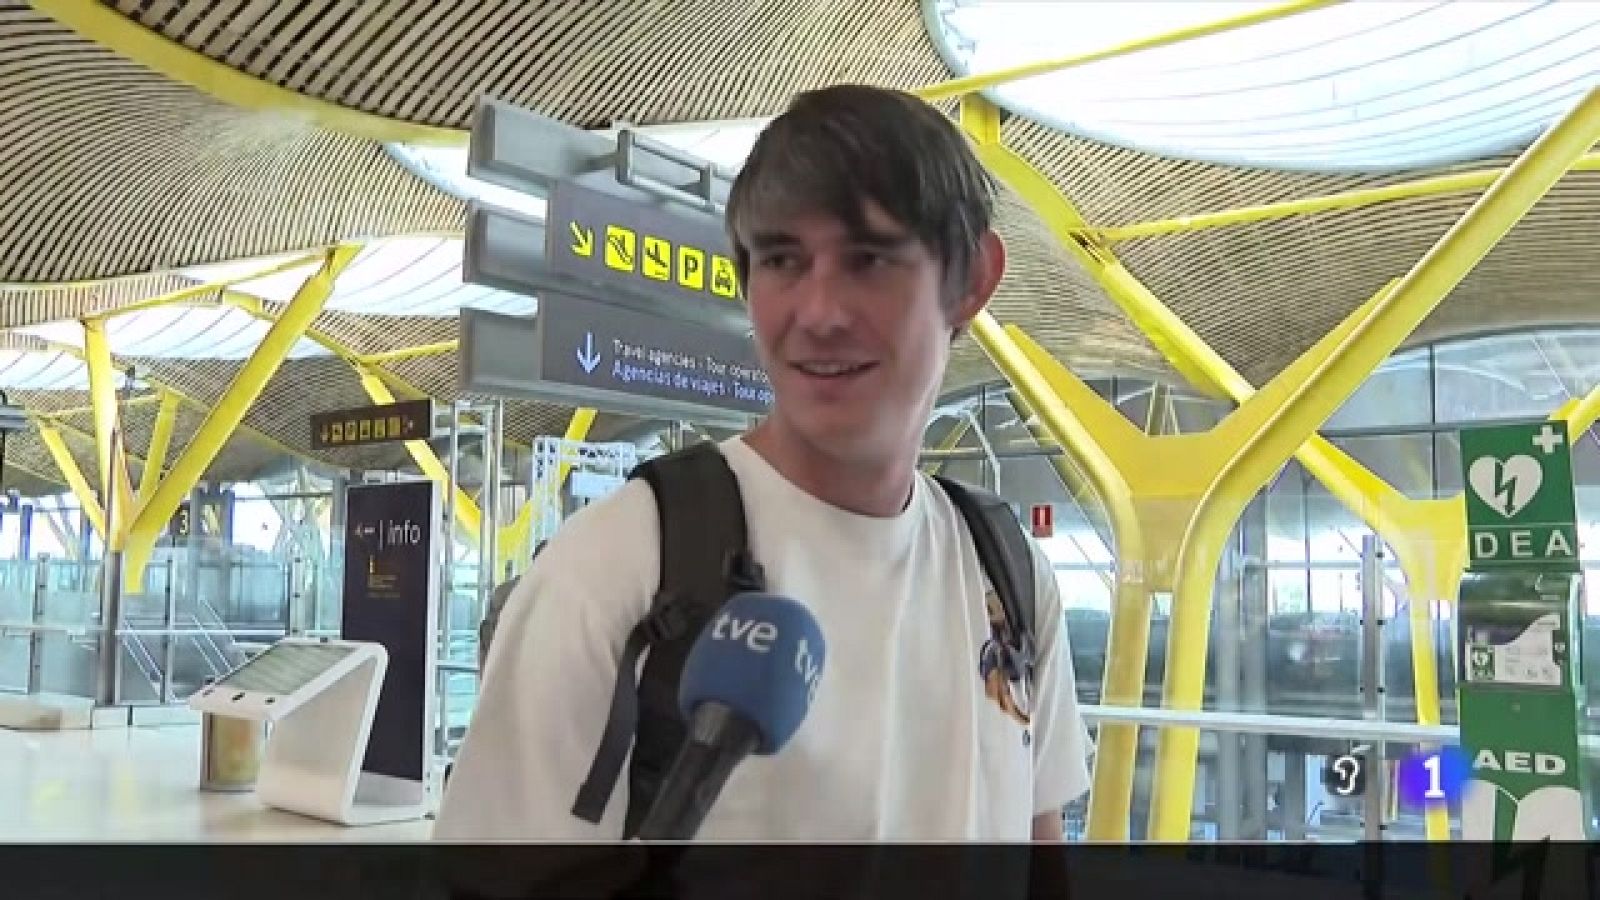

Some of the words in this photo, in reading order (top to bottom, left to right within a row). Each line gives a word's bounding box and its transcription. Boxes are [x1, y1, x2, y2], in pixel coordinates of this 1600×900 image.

[684, 253, 698, 281] P
[613, 339, 646, 361] Travel
[648, 349, 696, 370] agencies
[706, 357, 726, 376] Tour
[612, 359, 671, 386] Agencias
[673, 373, 689, 389] de
[690, 377, 726, 399] viajes
[734, 381, 756, 401] Tour
[387, 519, 421, 546] info
[1474, 529, 1572, 558] DEA
[712, 612, 778, 653] tve
[1472, 749, 1566, 775] AED
